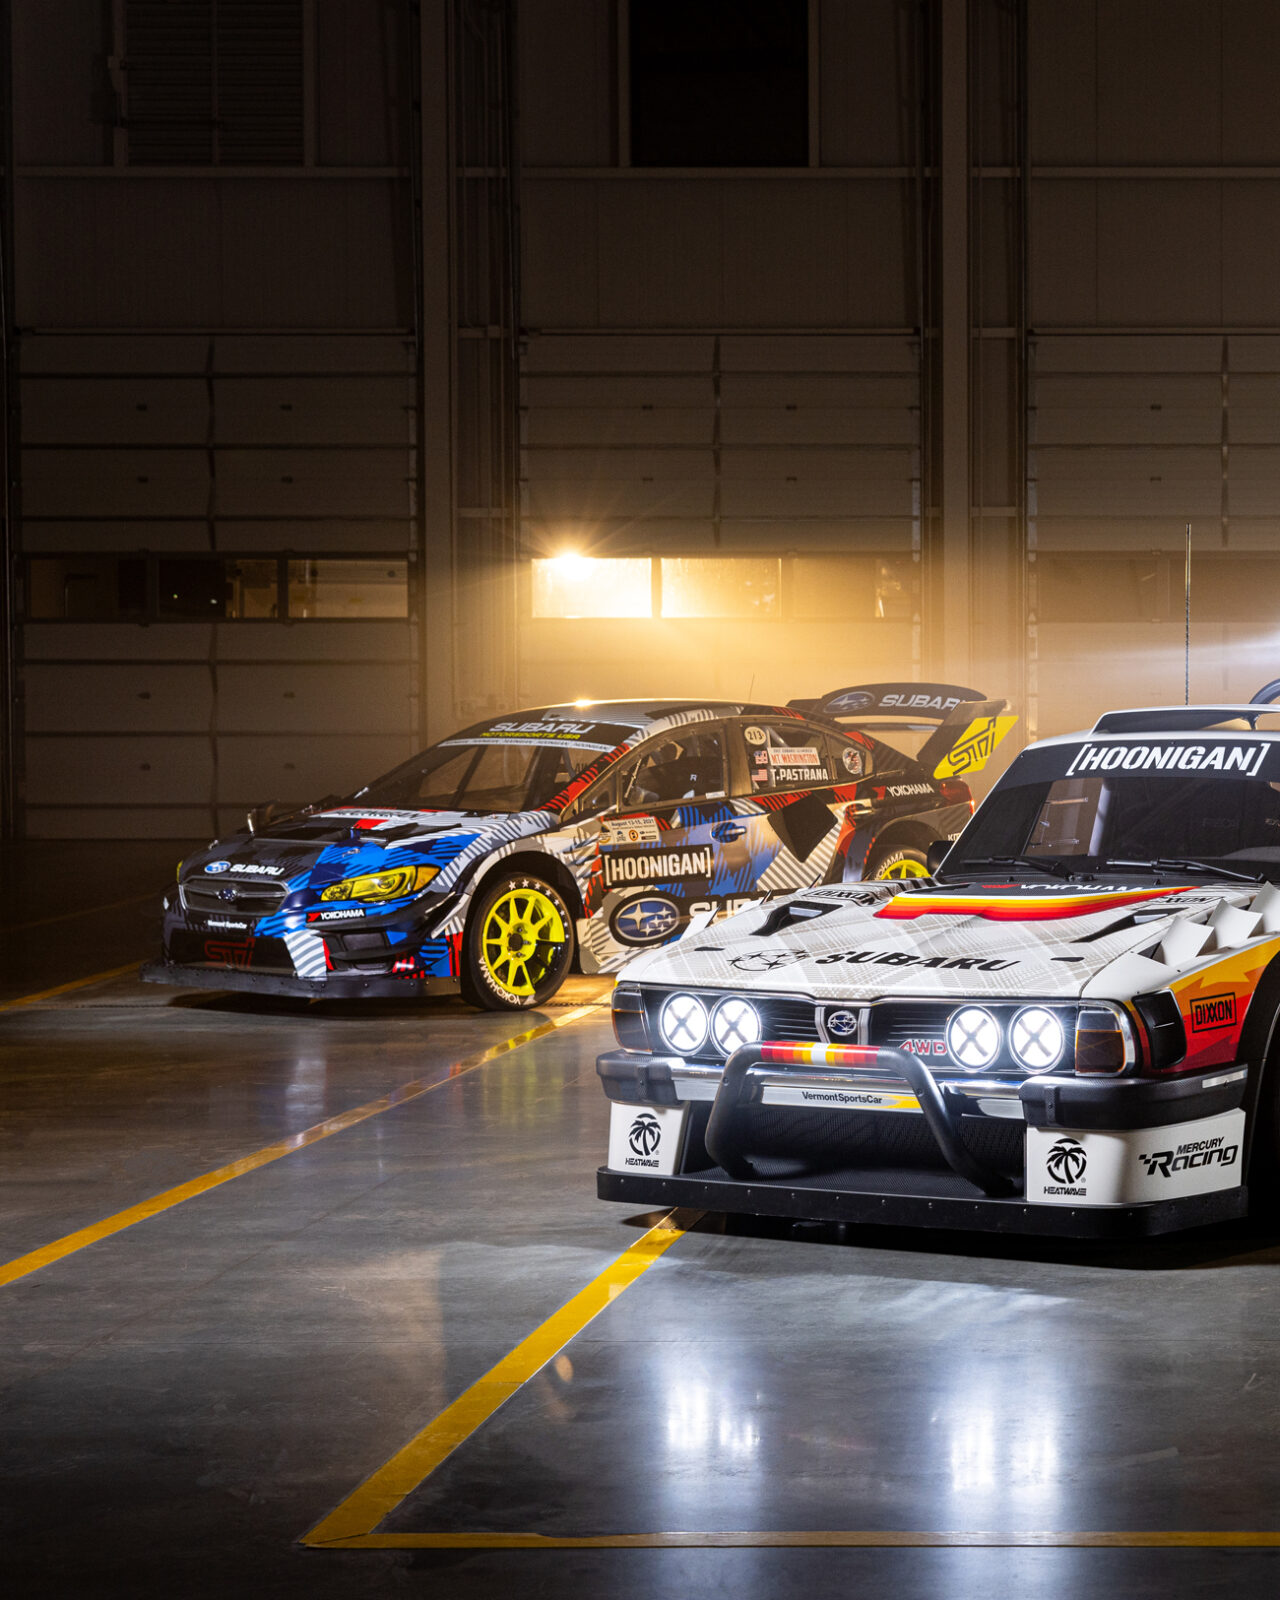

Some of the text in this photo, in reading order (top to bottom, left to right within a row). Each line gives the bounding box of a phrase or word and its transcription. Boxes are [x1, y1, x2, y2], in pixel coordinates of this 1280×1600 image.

[879, 694, 966, 711] SUBAR
[489, 722, 596, 734] SUBARU
[747, 730, 763, 740] 213
[1065, 742, 1271, 776] [HOONIGAN]
[887, 783, 934, 797] YOKOHAMA
[230, 864, 285, 875] SUBARU
[604, 847, 712, 886] [HOONIGAN]
[321, 908, 364, 920] YOKOHAMA
[815, 951, 1022, 971] SUBARU
[478, 957, 520, 1005] YOKOHAMA
[1195, 999, 1232, 1025] DIXXON
[899, 1039, 947, 1056] 4WD
[1177, 1136, 1224, 1154] MERCURY
[1143, 1145, 1239, 1178] Racing
[1043, 1186, 1087, 1196] HEATWAVE
